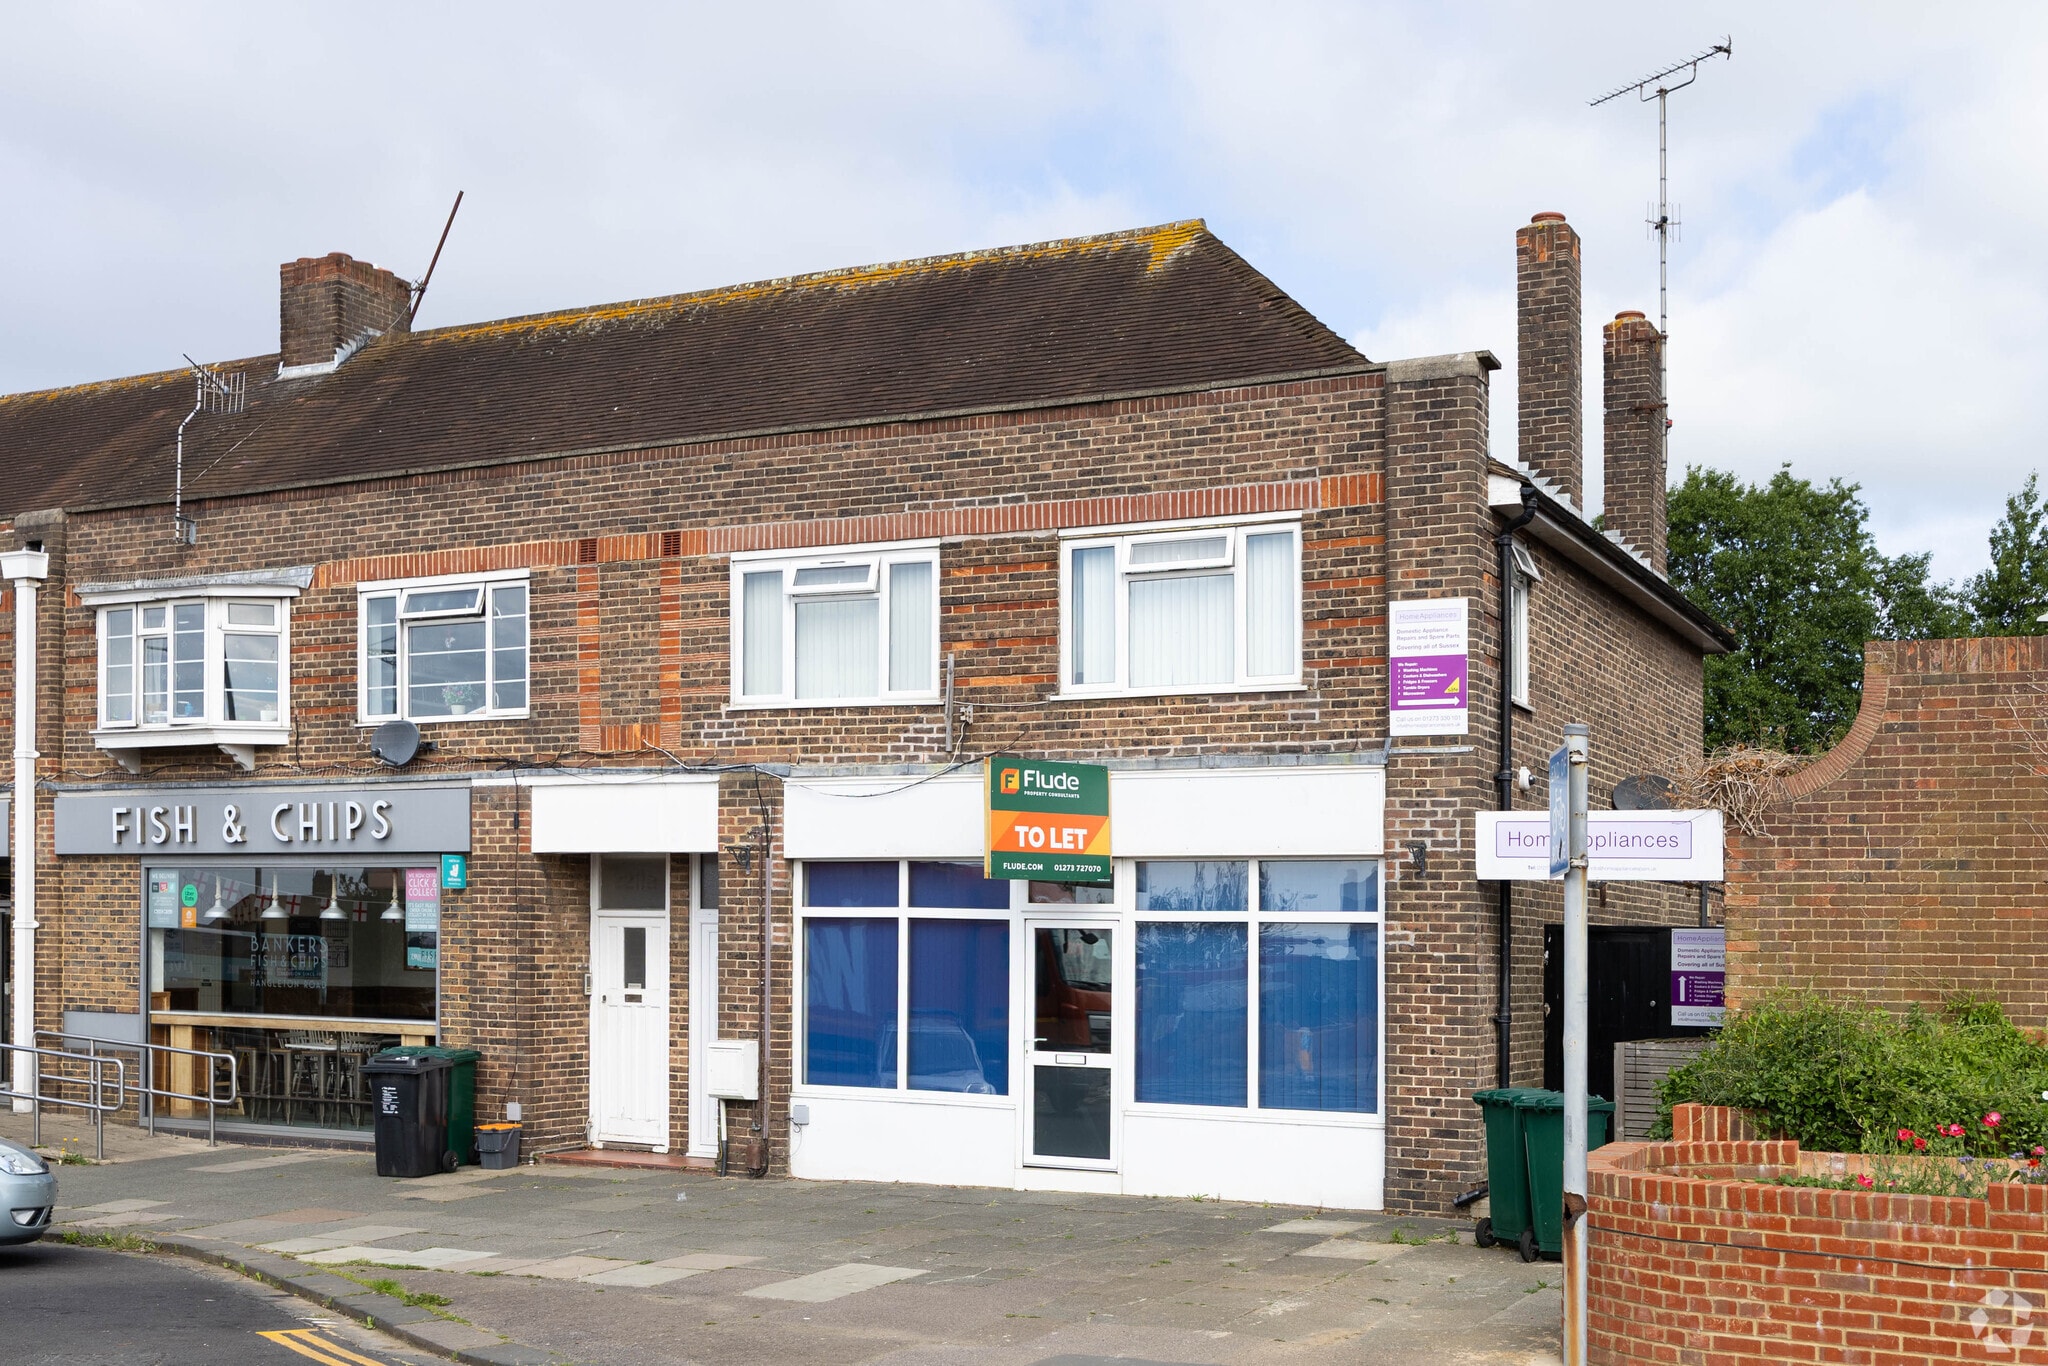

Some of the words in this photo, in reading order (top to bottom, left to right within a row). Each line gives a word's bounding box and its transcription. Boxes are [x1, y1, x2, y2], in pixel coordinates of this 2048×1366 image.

[1024, 769, 1080, 790] Flude
[112, 805, 197, 844] FISH
[222, 804, 247, 843] &
[271, 799, 392, 842] CHIPS
[1014, 825, 1045, 848] TO
[1050, 827, 1088, 850] LET
[1003, 862, 1043, 871] FLUDE.COM
[1054, 864, 1075, 872] 01273
[408, 879, 429, 887] CLICK
[432, 879, 437, 887] &
[408, 888, 437, 896] COLLECT
[251, 936, 328, 953] BANKERS
[250, 979, 299, 987] HANGLETON
[304, 980, 326, 989] ROAD
